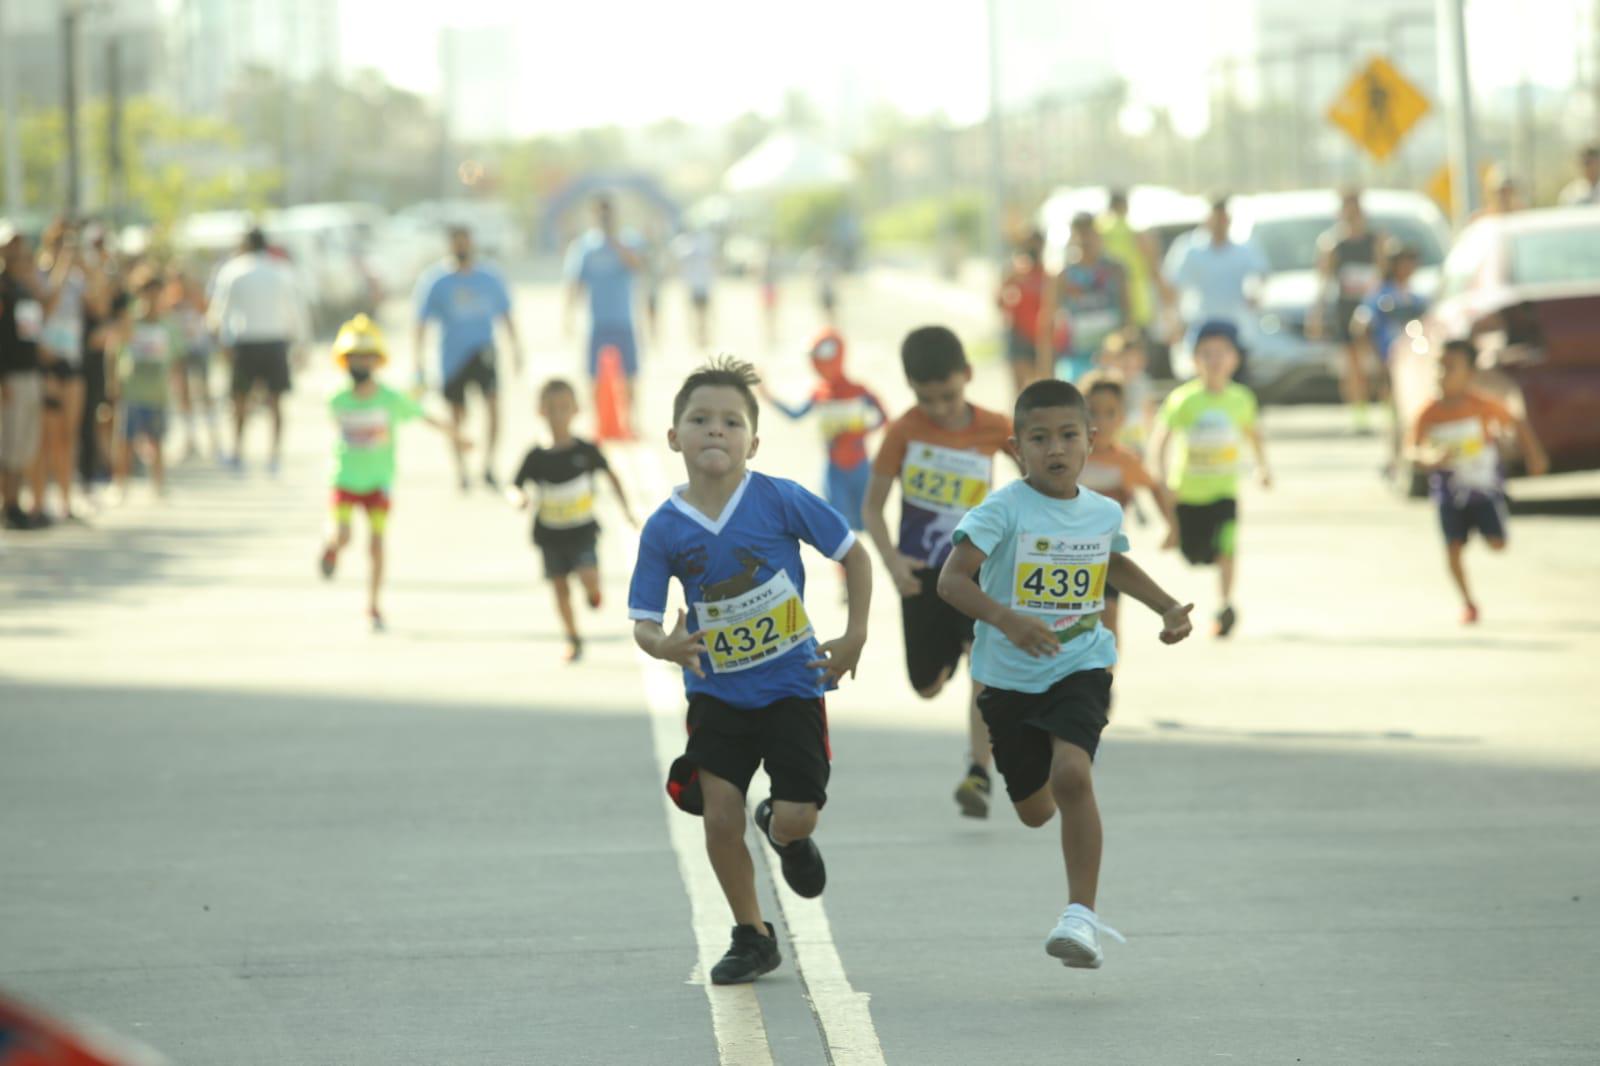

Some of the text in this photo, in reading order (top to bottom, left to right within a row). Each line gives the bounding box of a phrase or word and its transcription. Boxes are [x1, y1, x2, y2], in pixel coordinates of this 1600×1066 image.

[910, 472, 962, 500] 421
[1023, 567, 1090, 598] 439
[714, 617, 780, 656] 432
